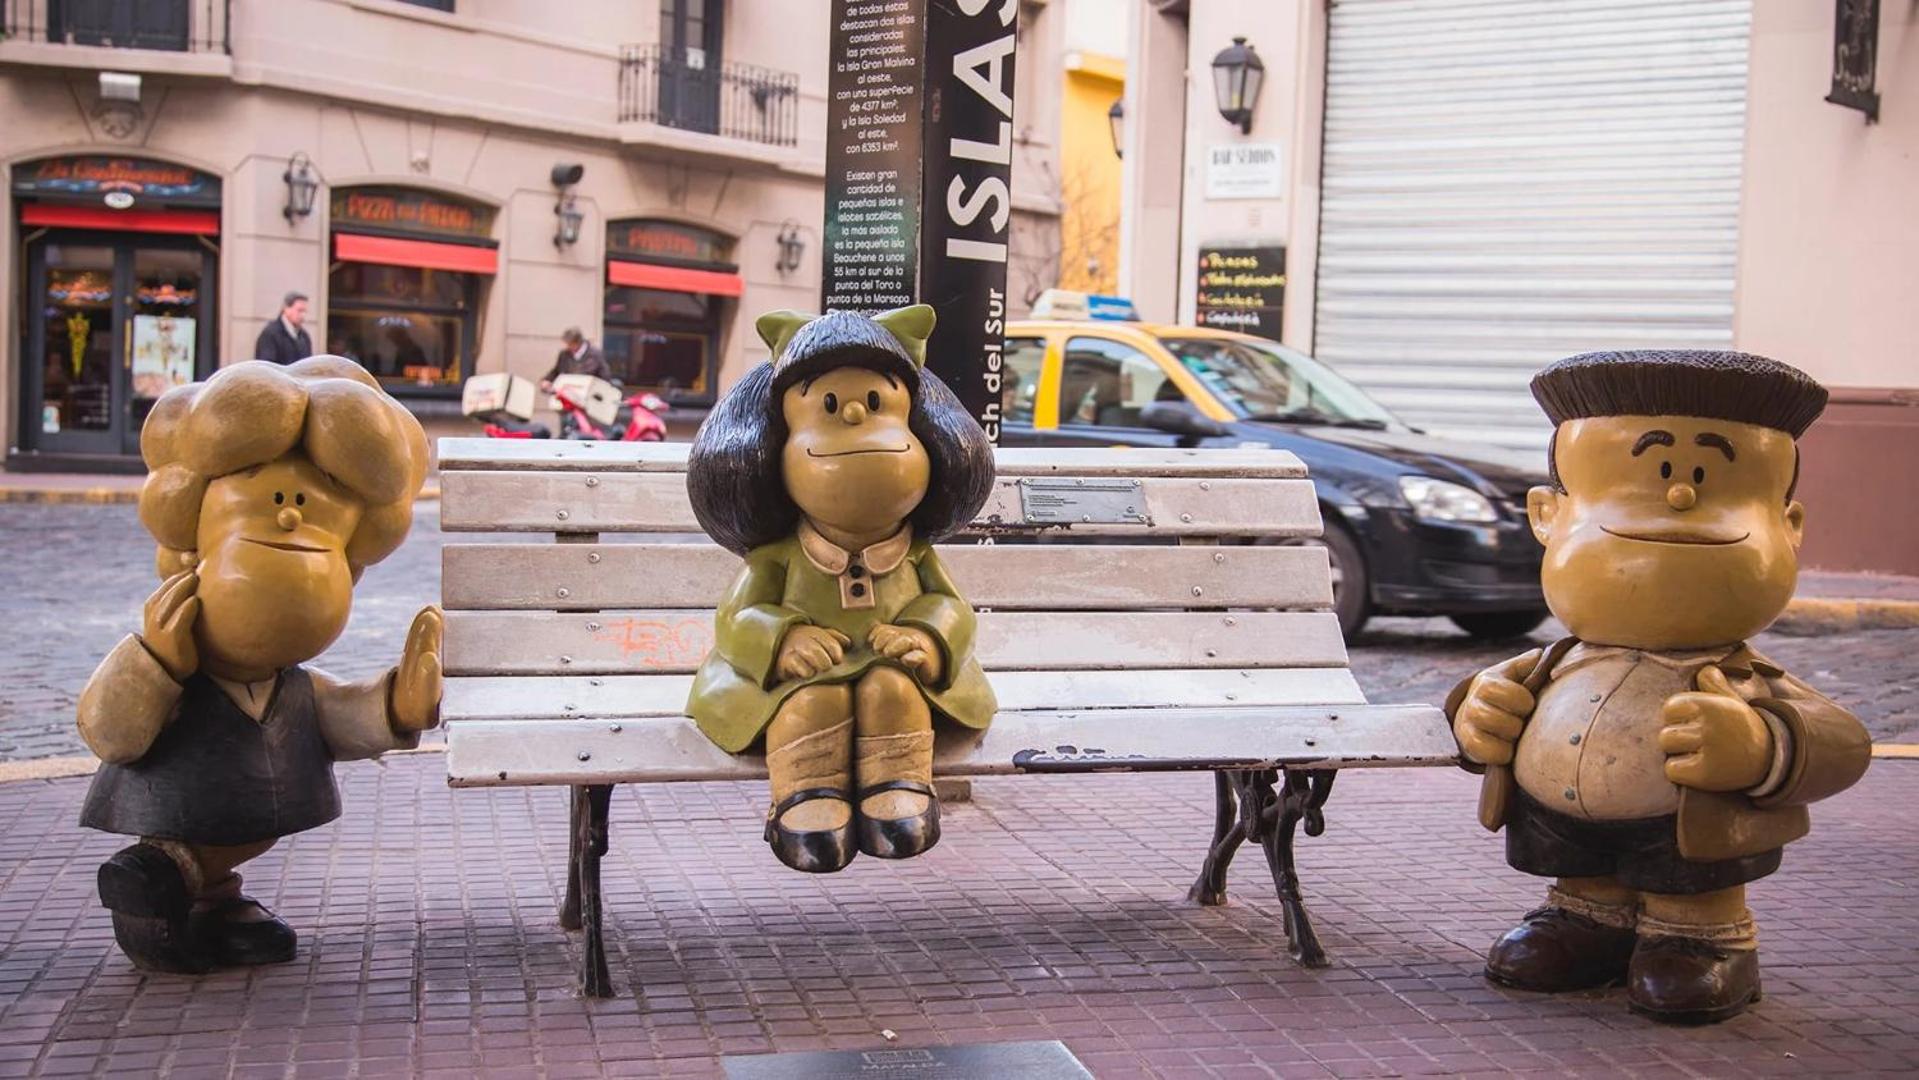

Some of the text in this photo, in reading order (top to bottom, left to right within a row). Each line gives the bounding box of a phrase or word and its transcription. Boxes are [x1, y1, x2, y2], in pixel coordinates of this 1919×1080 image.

[846, 2, 909, 16] de todas estas
[840, 14, 916, 31] destacan dos islas
[848, 30, 904, 43] consideradas
[846, 48, 858, 58] las
[837, 62, 845, 72] la
[861, 60, 882, 70] Gran
[884, 56, 916, 68] Malvina
[857, 74, 866, 84] al
[836, 90, 851, 100] con
[852, 89, 868, 98] una
[849, 102, 860, 112] de
[862, 100, 880, 111] 4377
[842, 119, 848, 130] y
[848, 116, 856, 126] la
[872, 112, 907, 124] Soledad
[858, 130, 866, 139] al
[846, 145, 860, 154] con
[846, 170, 898, 182] Existen gran
[846, 183, 896, 195] cantidad de
[838, 196, 904, 210] pequeñas islas e
[838, 212, 864, 222] islotes
[842, 224, 898, 236] la más aislada
[834, 238, 905, 252] es la pequeña isla
[834, 252, 877, 263] Beauchene
[886, 254, 905, 262] unos
[834, 266, 904, 276] 55 km al sur de la
[835, 281, 860, 292] punta
[860, 280, 873, 290] del
[875, 280, 894, 290] Toro
[826, 293, 910, 306] punta de la Marsopa
[984, 288, 1004, 335] Sur
[983, 344, 1001, 394] del
